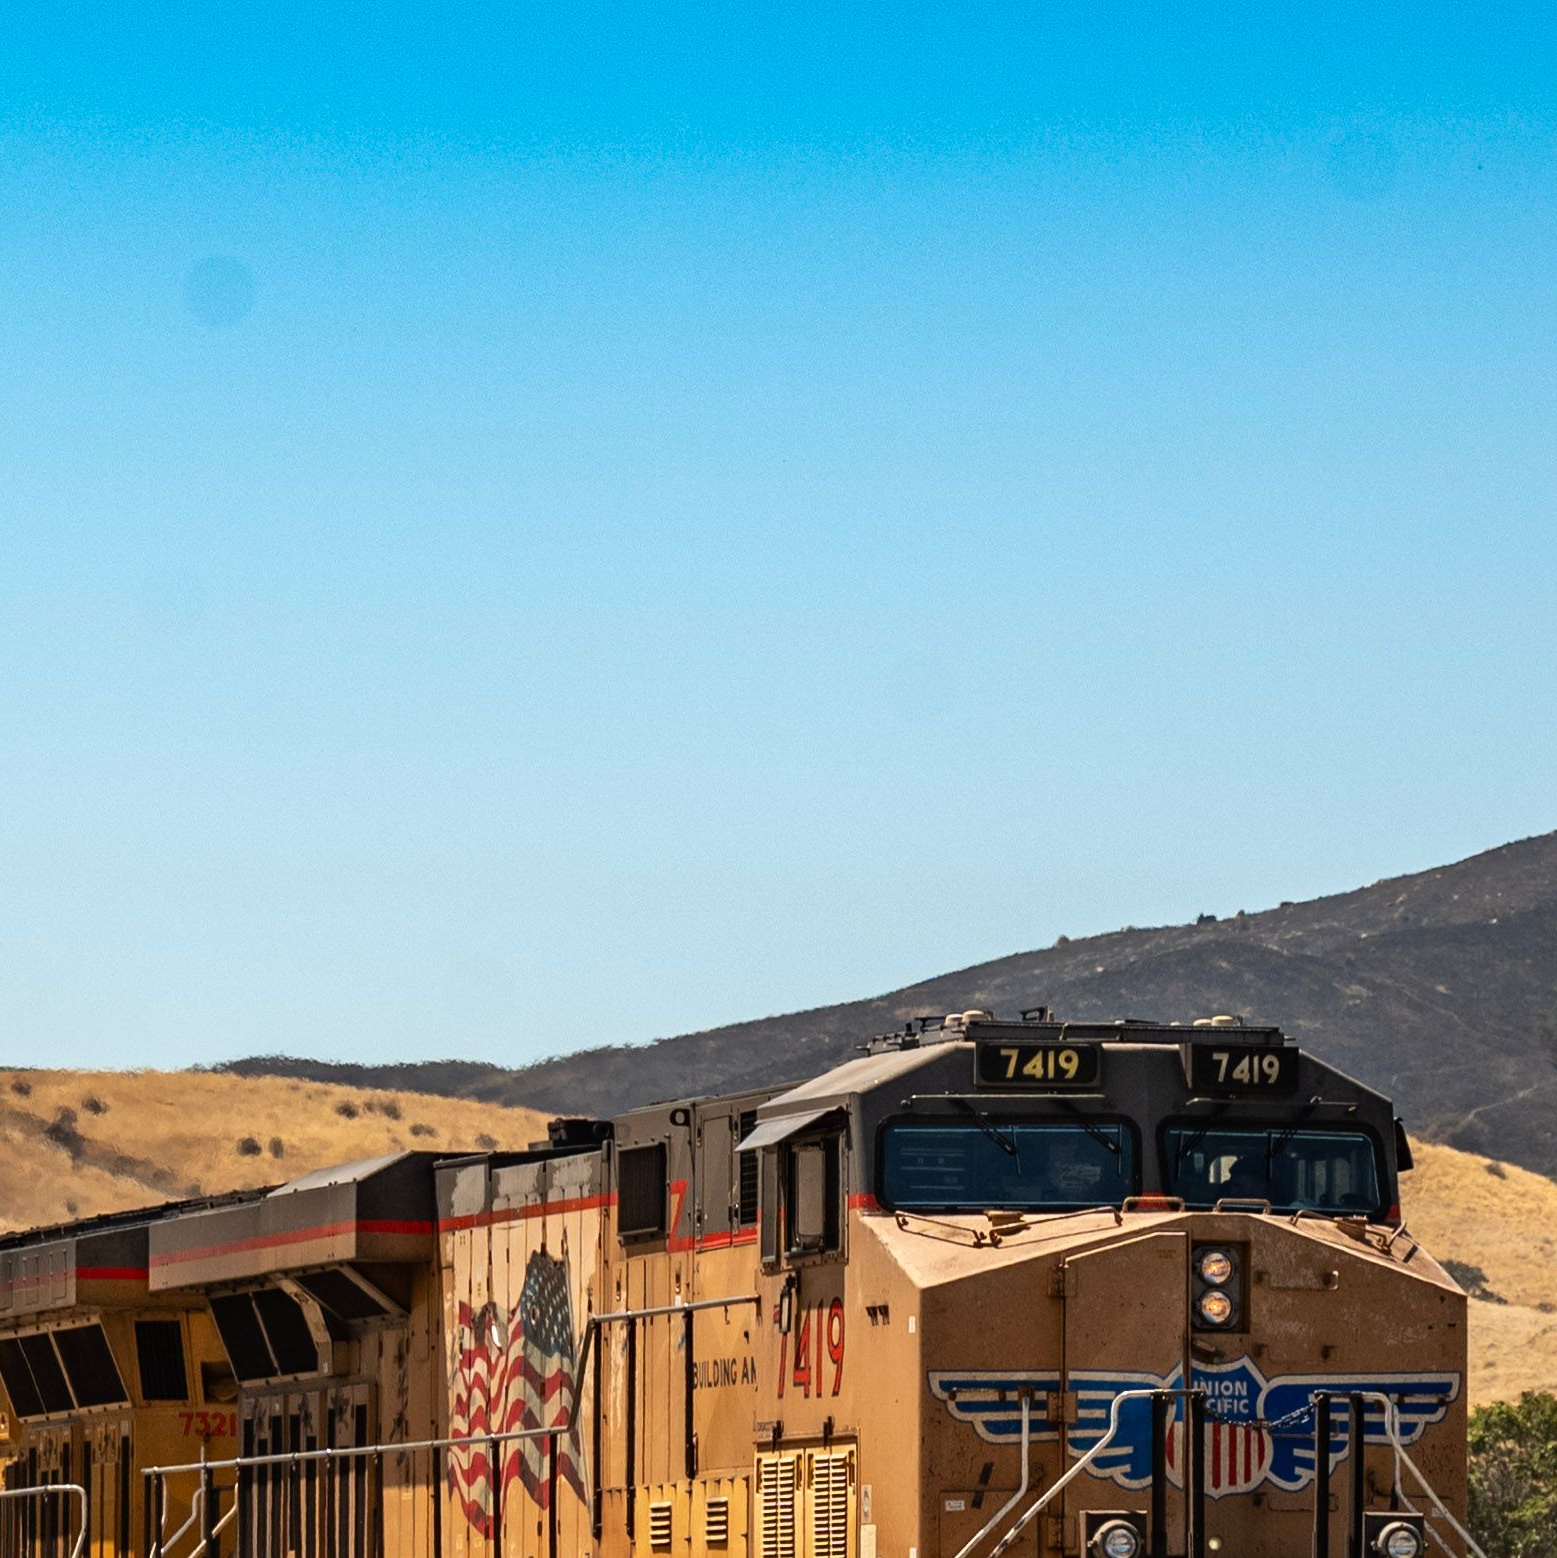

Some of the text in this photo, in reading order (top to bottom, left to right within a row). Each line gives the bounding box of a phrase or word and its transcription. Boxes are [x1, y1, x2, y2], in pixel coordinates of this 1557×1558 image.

[999, 1047, 1080, 1080] 7419
[1211, 1051, 1281, 1085] 7419
[773, 1296, 845, 1399] 7419
[693, 1361, 738, 1390] BUILDING
[1204, 1398, 1250, 1415] CIFIC
[179, 1411, 237, 1437] 7321
